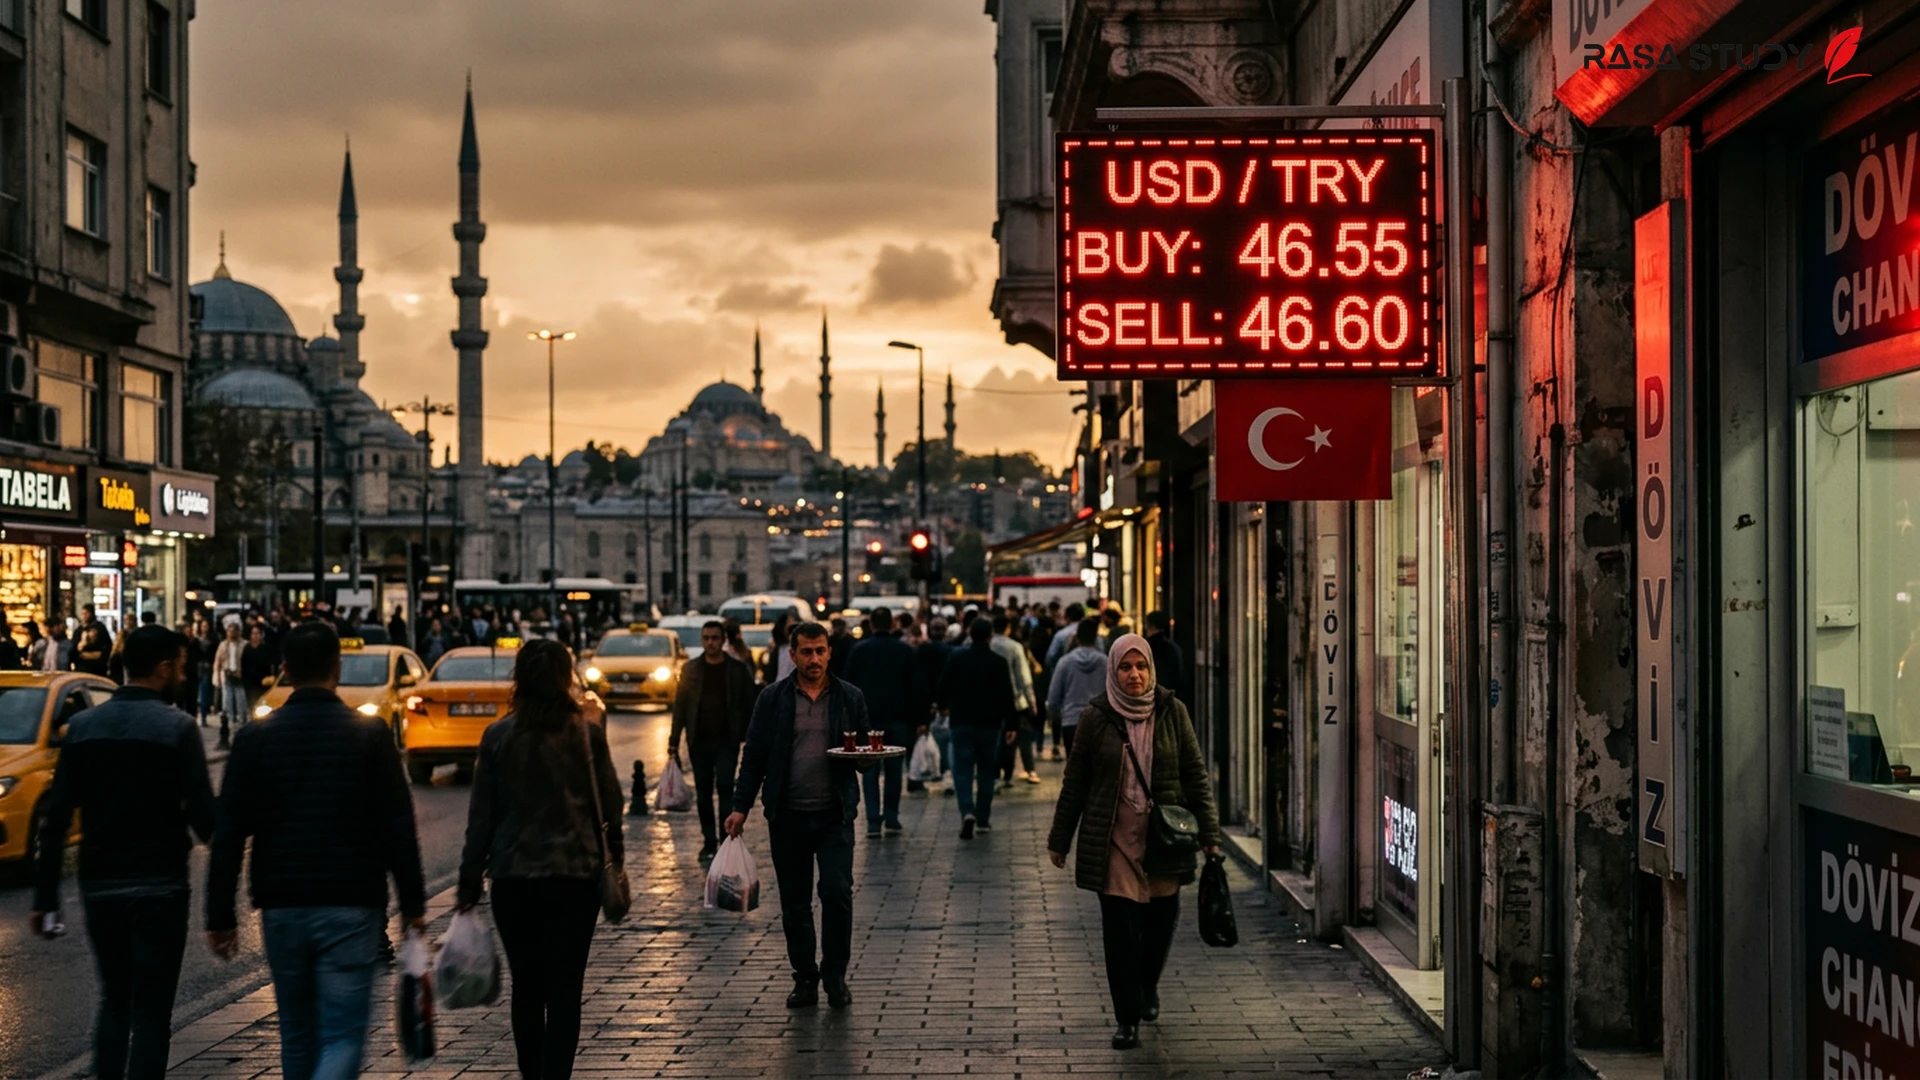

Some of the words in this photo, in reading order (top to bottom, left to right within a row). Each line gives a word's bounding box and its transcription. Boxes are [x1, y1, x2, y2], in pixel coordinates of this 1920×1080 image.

[1107, 159, 1221, 203] USD
[1238, 159, 1257, 203] /
[1271, 159, 1385, 203] TRY
[1077, 230, 1201, 274] BUY:
[1238, 222, 1408, 278] 46.55
[1077, 302, 1223, 346] SELL:
[1239, 295, 1408, 351] 46.60
[0, 468, 71, 511] TABELA
[1821, 843, 1920, 946] DÖVİZ
[1821, 946, 1920, 1048] CHAN
